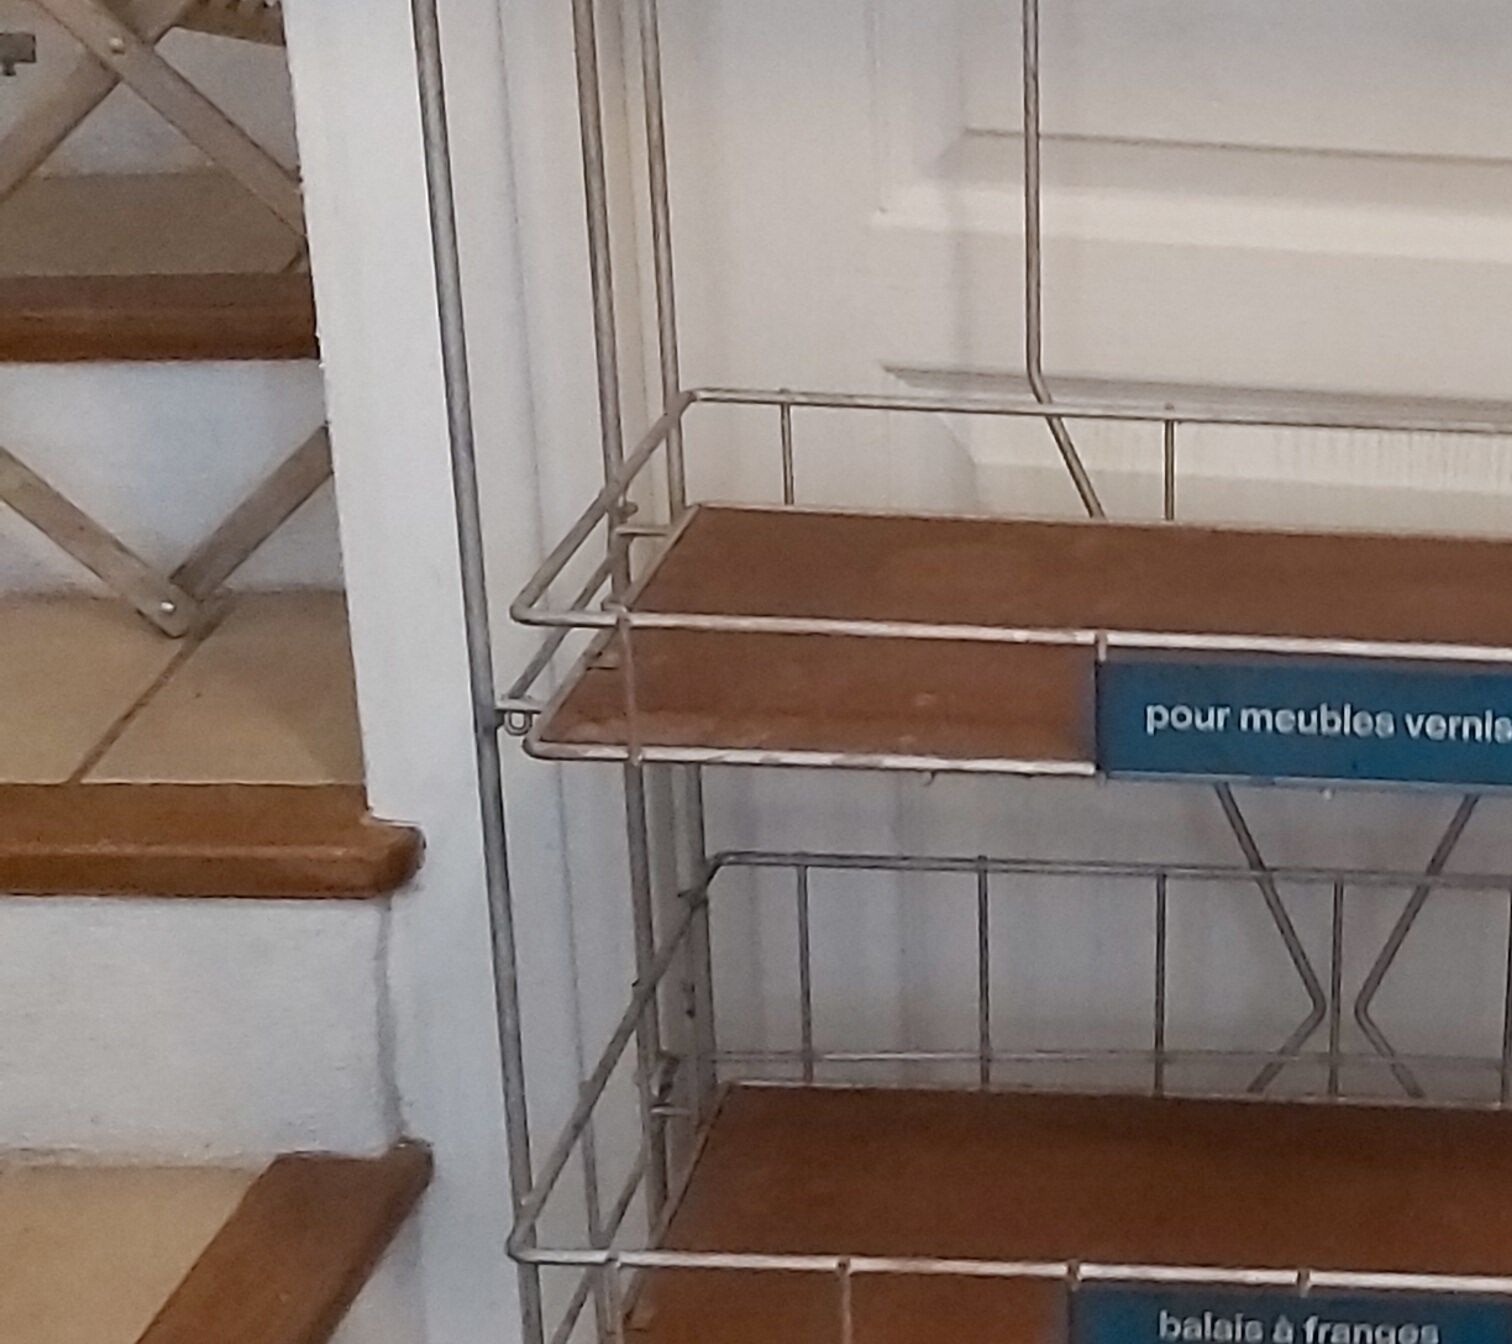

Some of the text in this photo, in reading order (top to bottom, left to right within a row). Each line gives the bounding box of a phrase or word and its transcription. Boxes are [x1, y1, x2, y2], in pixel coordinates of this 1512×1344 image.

[1146, 703, 1230, 734] pour
[1240, 703, 1394, 737] meubles
[1159, 1311, 1263, 1343] balais
